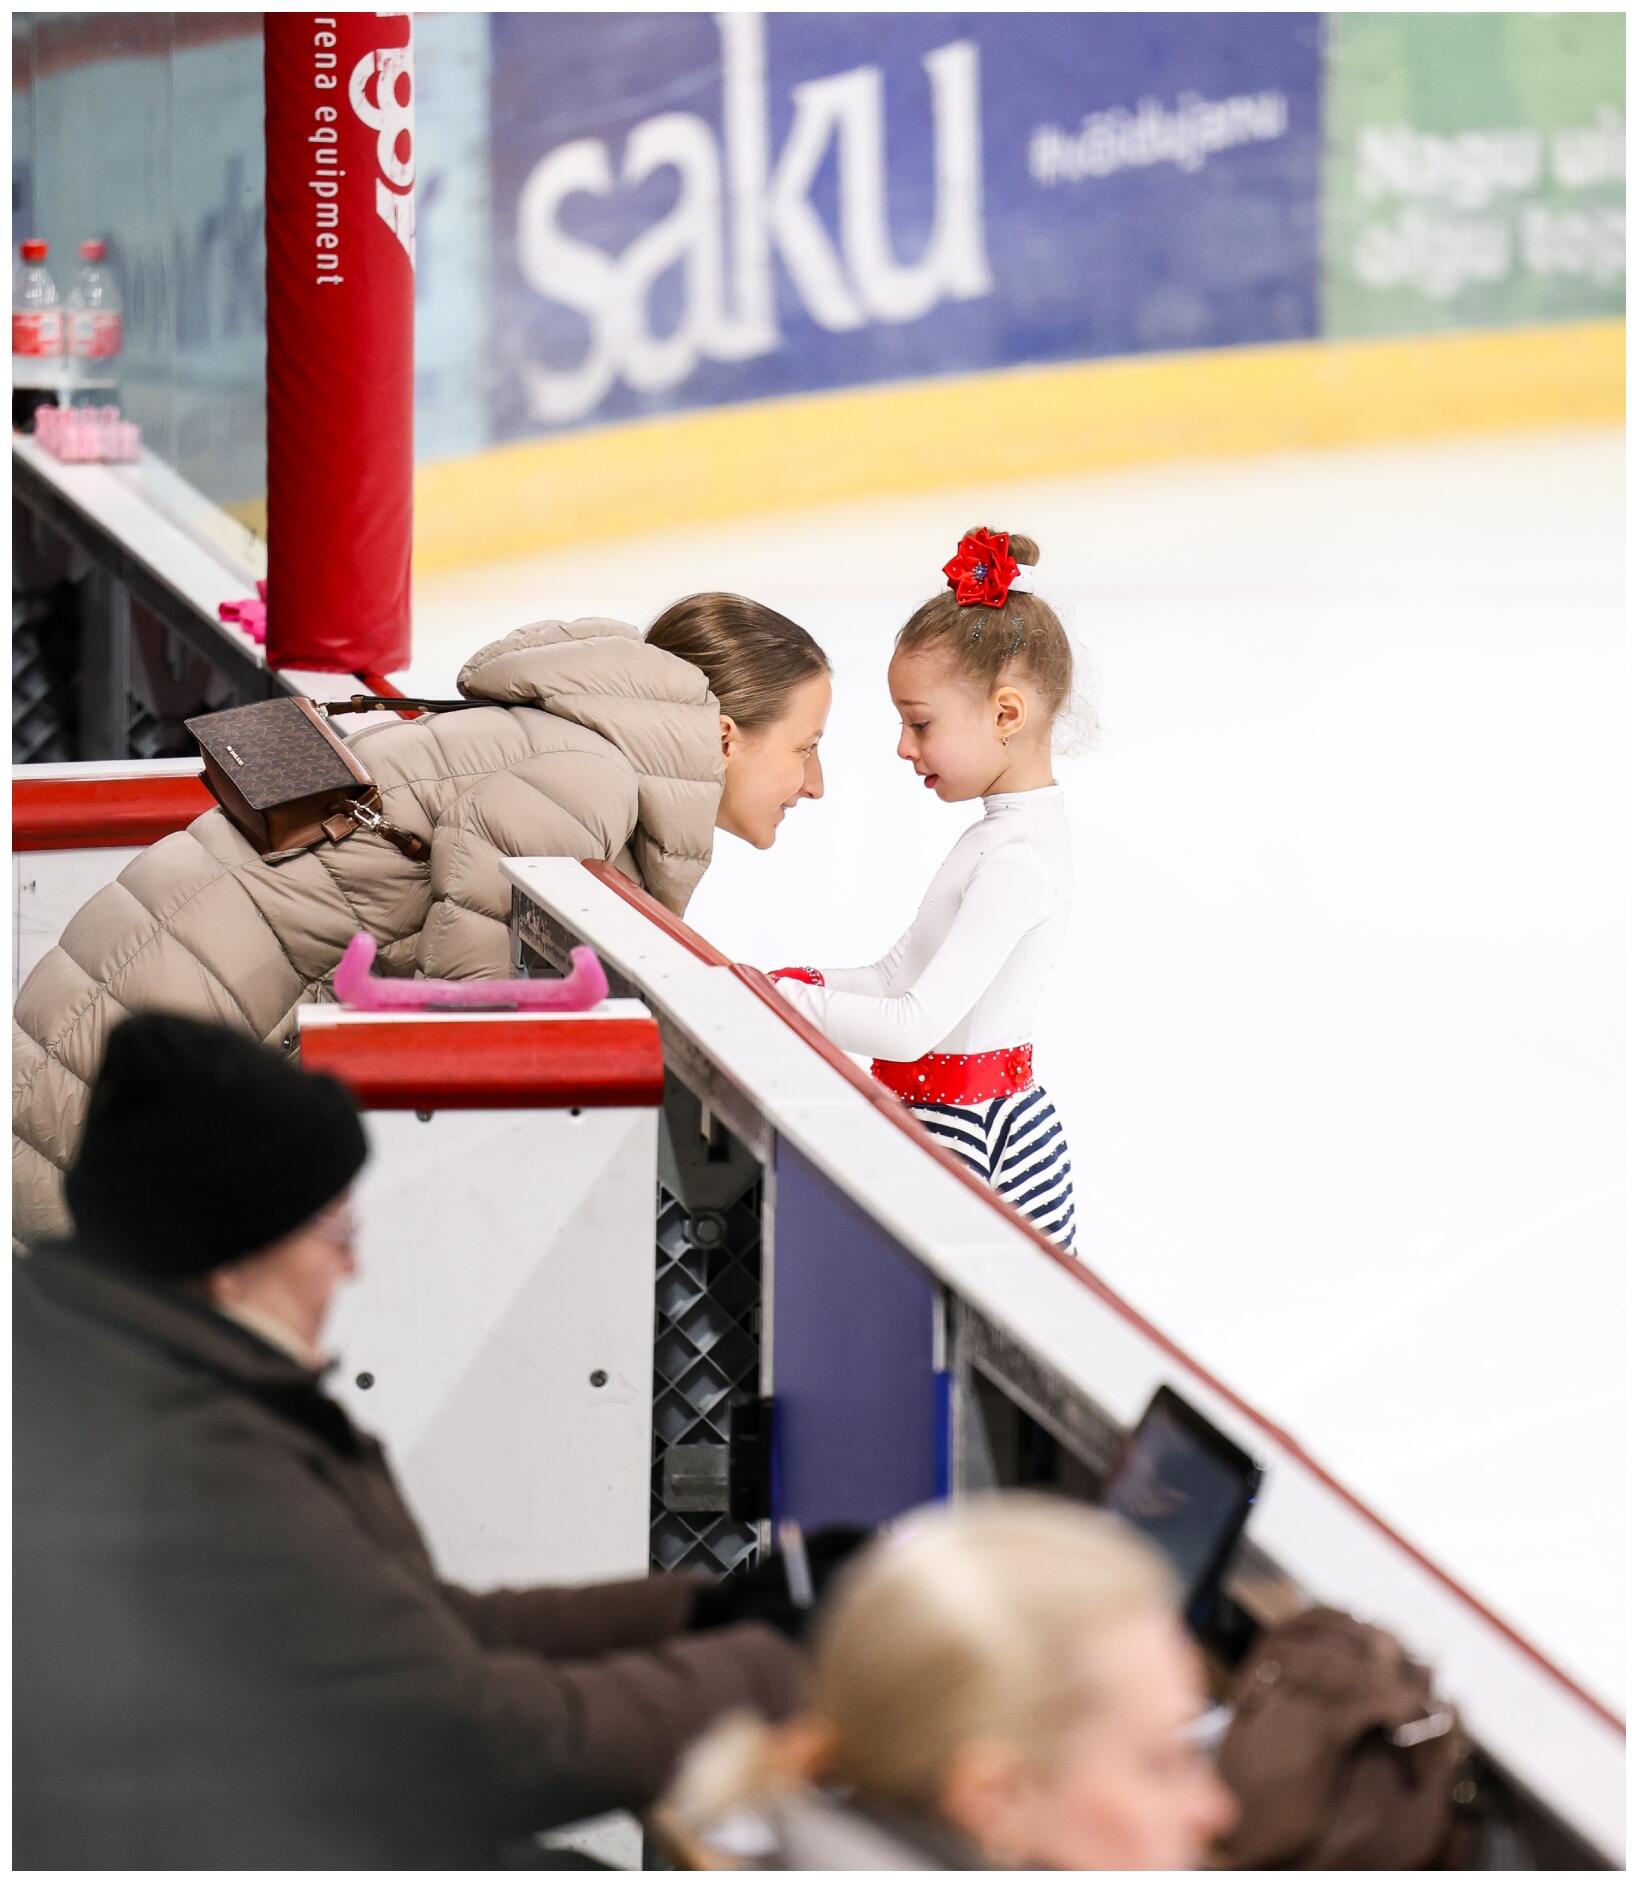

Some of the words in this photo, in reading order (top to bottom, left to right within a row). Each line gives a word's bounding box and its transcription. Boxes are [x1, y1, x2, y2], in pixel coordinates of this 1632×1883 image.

[314, 17, 338, 90] rena
[307, 105, 345, 286] equipment
[516, 12, 994, 423] saku
